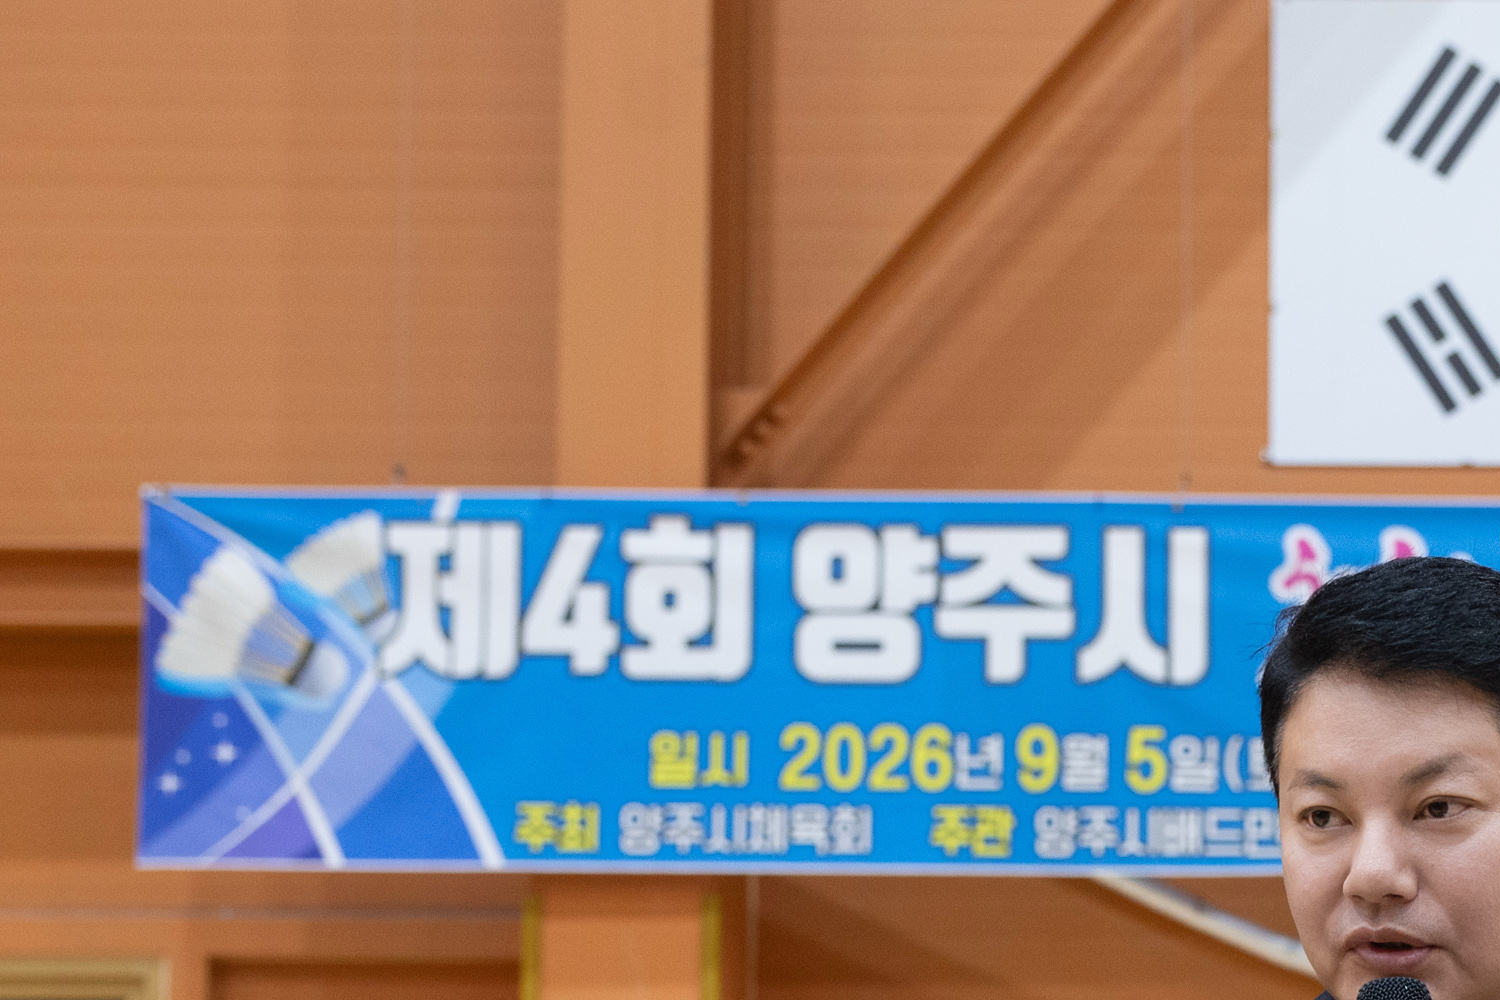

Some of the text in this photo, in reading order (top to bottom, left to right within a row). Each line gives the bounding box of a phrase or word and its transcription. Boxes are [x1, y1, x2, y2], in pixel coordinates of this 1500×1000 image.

[377, 514, 755, 682] 제4회
[792, 522, 1209, 686] 양주시
[649, 730, 749, 789] 일시
[778, 722, 1004, 793] 2026년
[1016, 724, 1110, 793] 9월
[514, 801, 601, 854] 주최
[618, 802, 873, 856] 양주시체육회
[930, 804, 1016, 858] 주관
